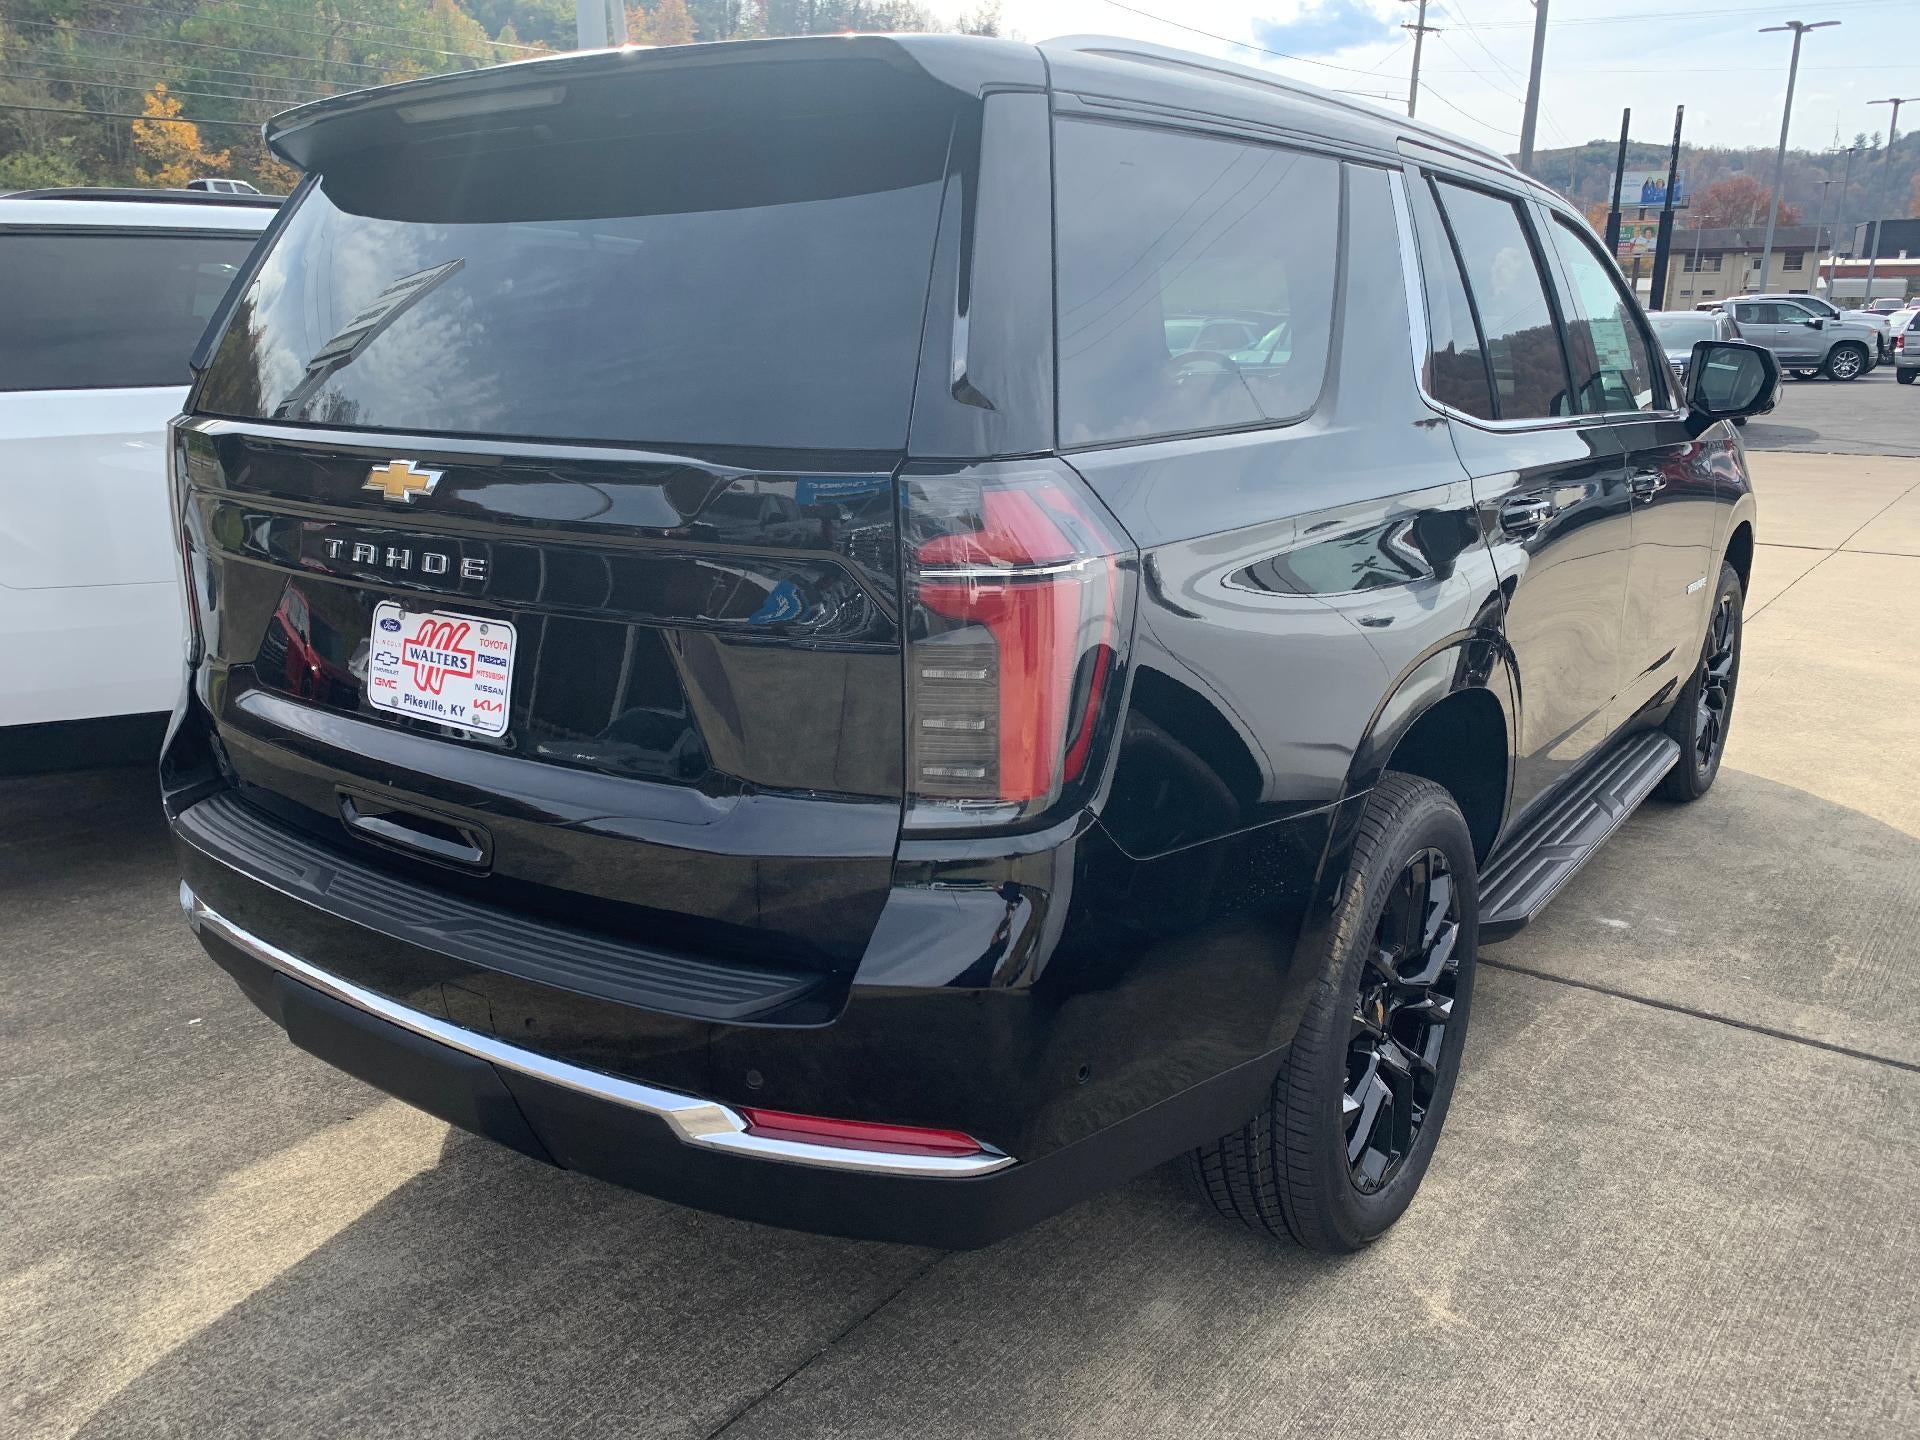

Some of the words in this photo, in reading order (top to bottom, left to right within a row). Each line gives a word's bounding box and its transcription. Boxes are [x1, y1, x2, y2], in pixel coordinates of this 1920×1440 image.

[324, 538, 489, 581] TAHOE
[382, 619, 400, 631] Ford
[479, 638, 508, 651] TOYOTA
[409, 647, 468, 670] WALTERS
[475, 669, 506, 681] MITSUBISHI
[374, 676, 398, 690] GMC
[474, 683, 504, 696] NISSAN
[403, 693, 447, 715] Pikeville,
[450, 704, 466, 717] KY
